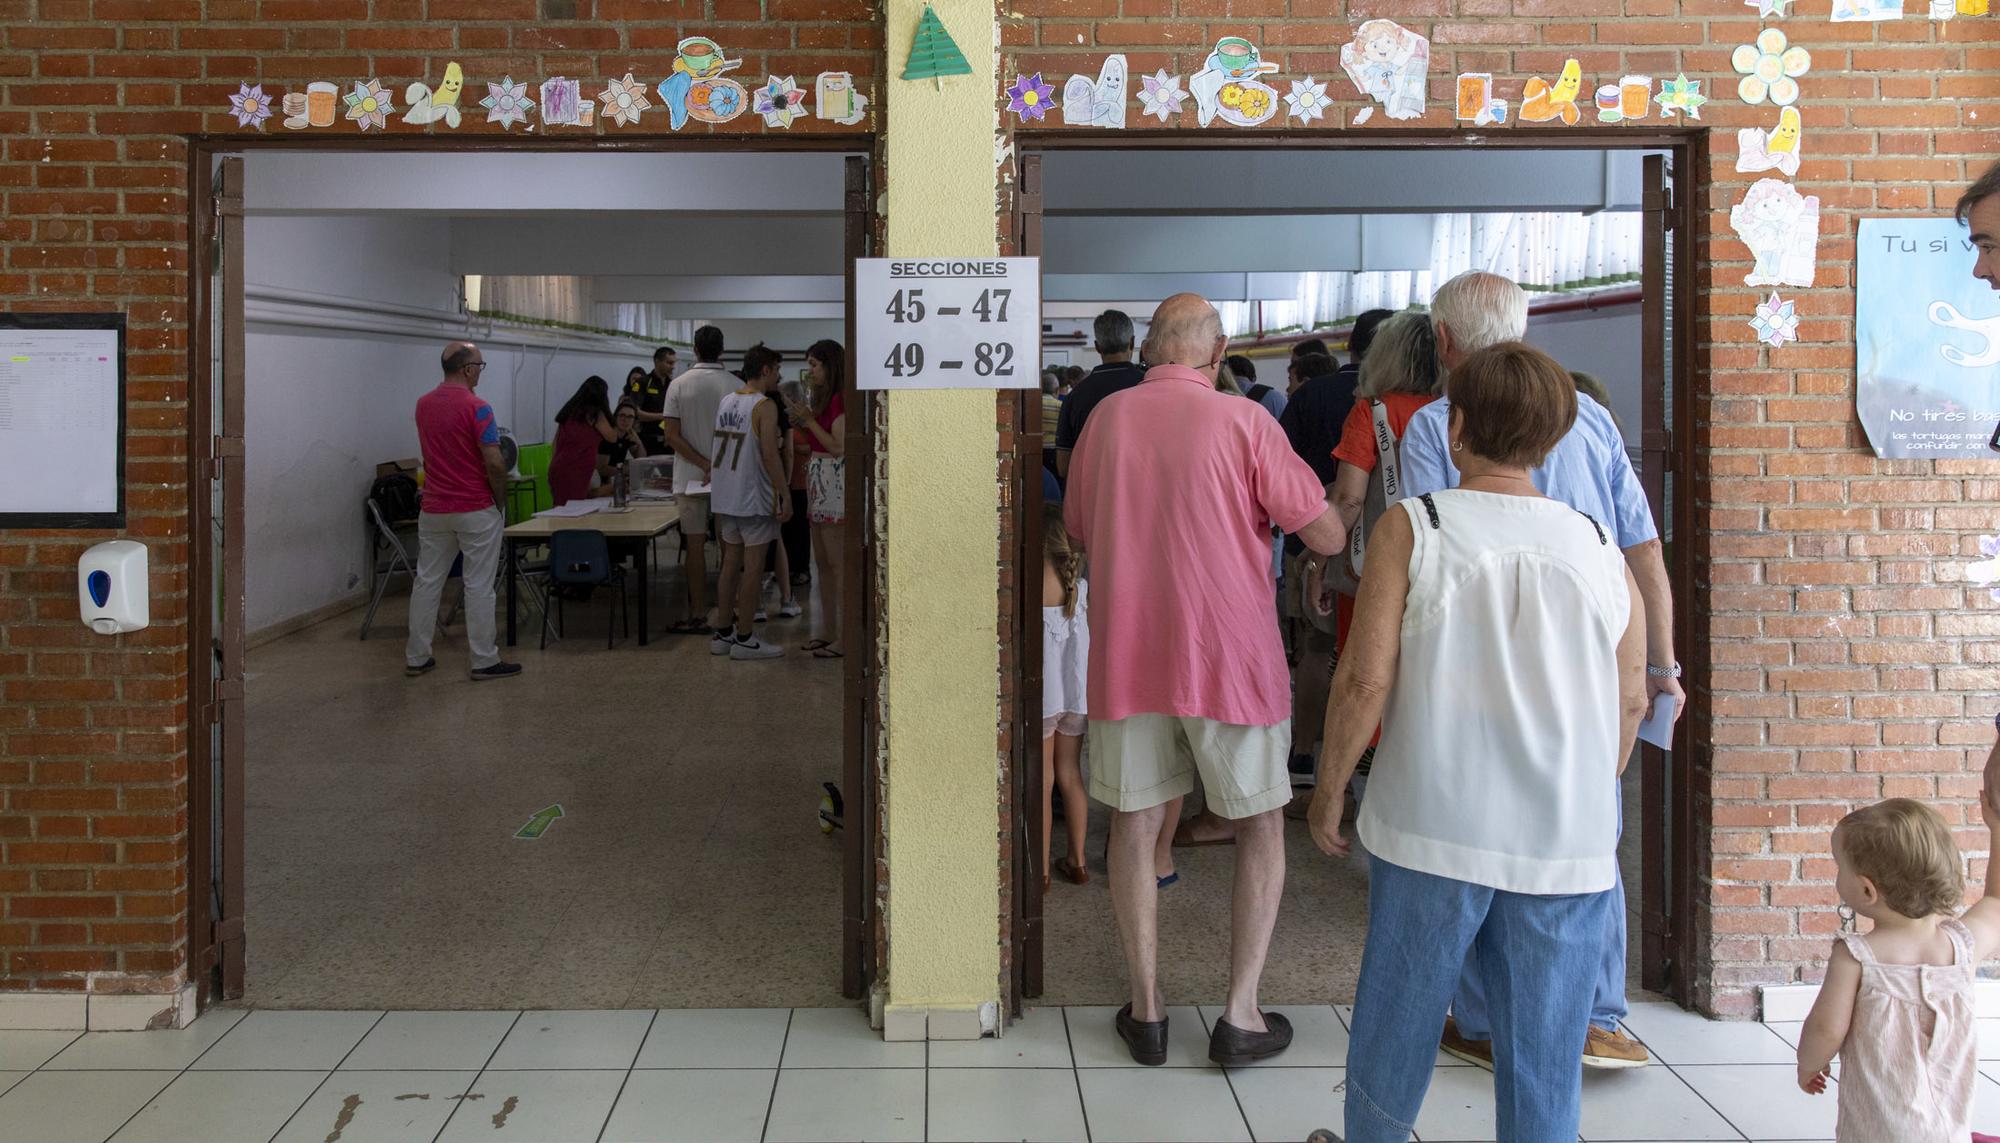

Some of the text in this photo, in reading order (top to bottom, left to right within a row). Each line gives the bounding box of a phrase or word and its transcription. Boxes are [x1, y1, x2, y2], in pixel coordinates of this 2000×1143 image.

[1881, 235, 1917, 253] Tu
[1928, 236, 1948, 253] si
[890, 262, 1008, 276] SECCIONES
[885, 288, 926, 323] 45
[971, 288, 1012, 323] 47
[884, 342, 925, 377] 49
[974, 341, 1014, 376] 82
[1889, 408, 1915, 421] No
[1921, 408, 1967, 421] tires
[1376, 419, 1390, 452] Chloé
[1891, 431, 1907, 440] las
[1911, 431, 1962, 443] tortugas
[1905, 440, 1987, 450] confundir con
[713, 430, 747, 472] 77
[1385, 464, 1397, 496] Chloé
